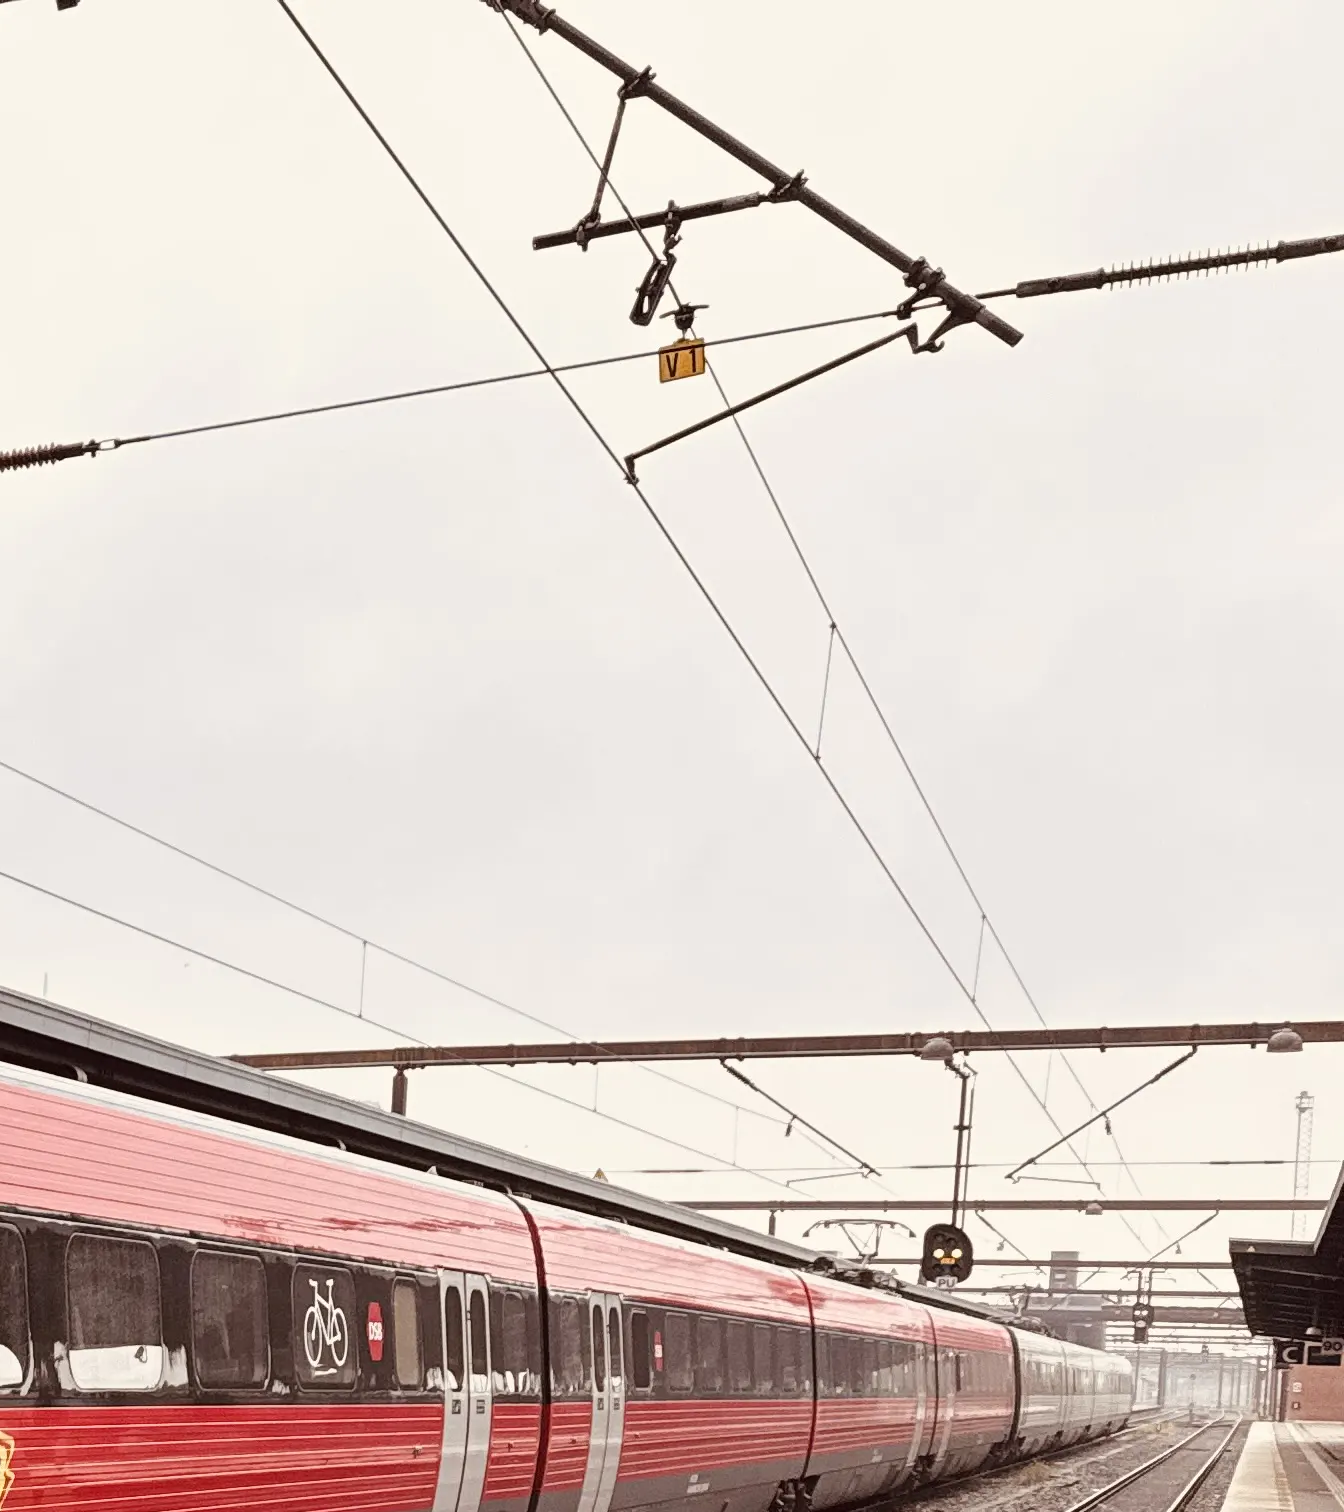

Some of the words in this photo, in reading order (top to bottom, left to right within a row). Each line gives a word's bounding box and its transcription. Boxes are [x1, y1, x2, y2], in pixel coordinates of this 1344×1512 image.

[938, 1278, 956, 1288] PU
[1282, 1347, 1299, 1363] C
[1323, 1341, 1343, 1351] 90
